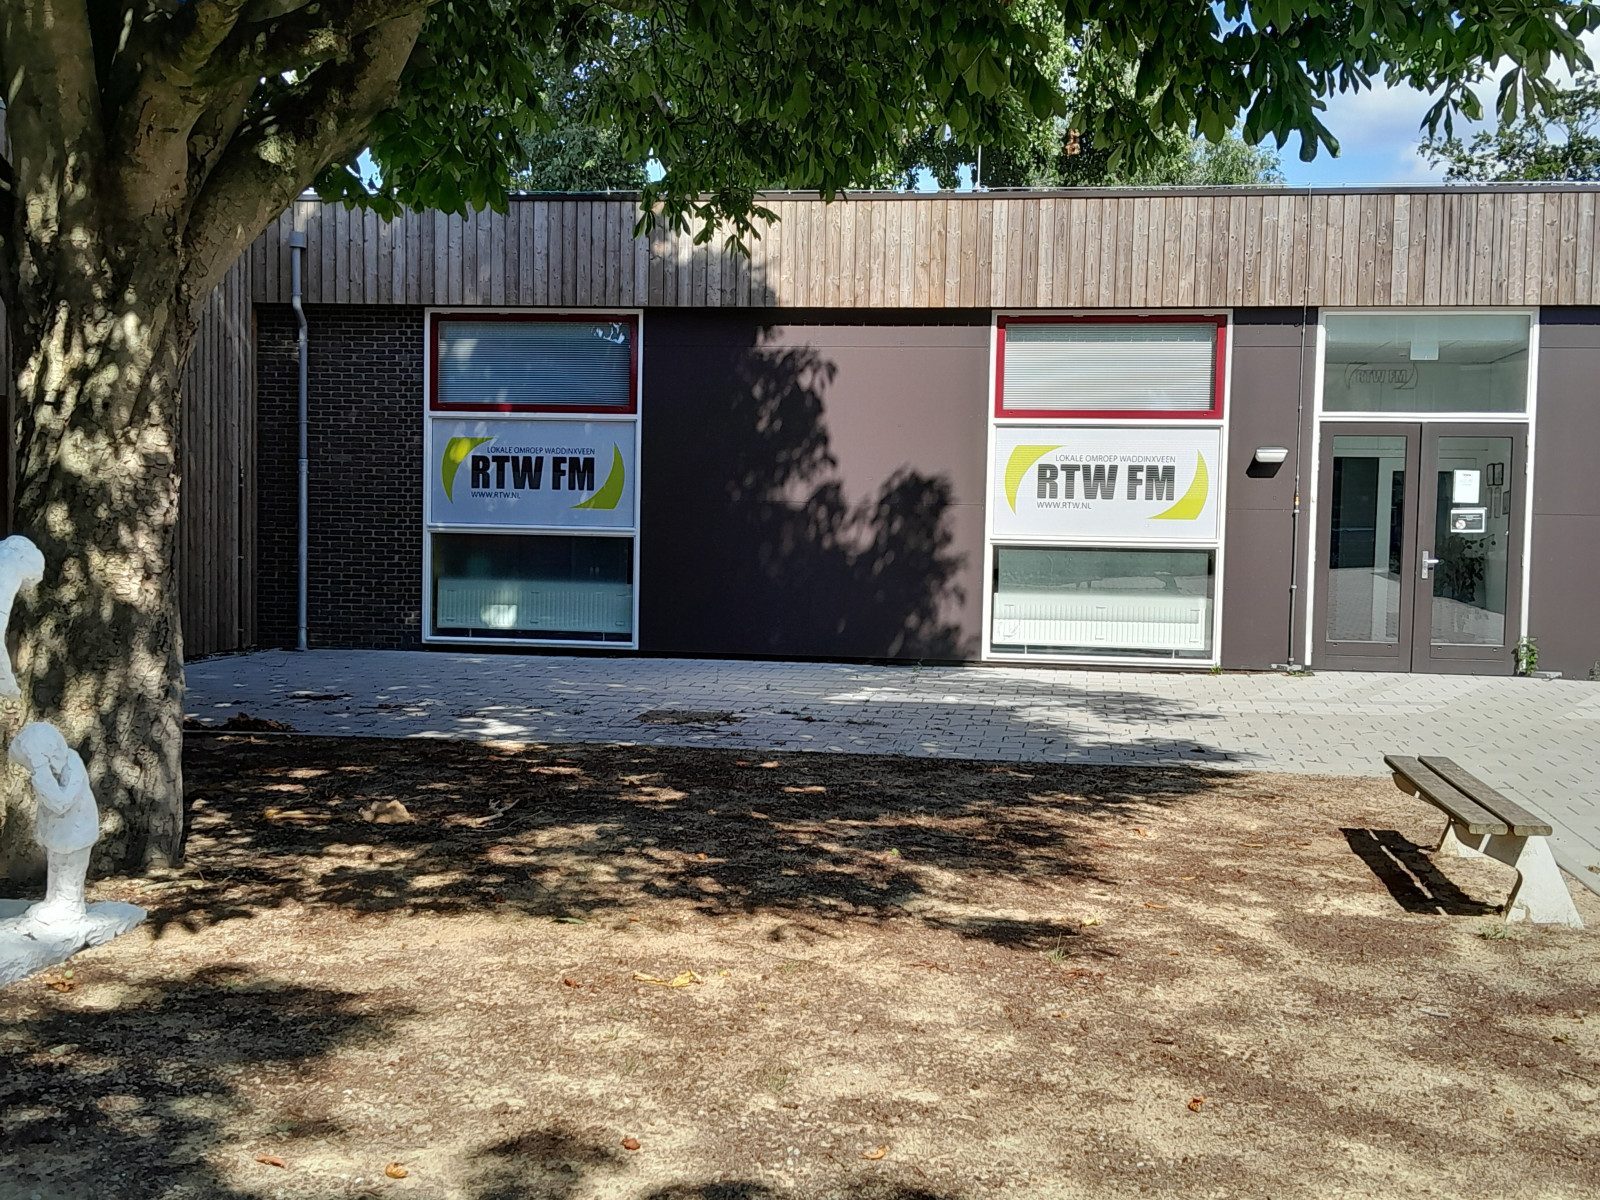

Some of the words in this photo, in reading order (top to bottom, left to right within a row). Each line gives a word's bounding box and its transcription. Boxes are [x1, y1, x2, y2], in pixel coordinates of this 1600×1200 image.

[1388, 369, 1408, 384] FM
[487, 446, 513, 454] LOKALE
[513, 446, 543, 454] OMROEP
[544, 447, 595, 456] WADDINXVEEN
[1055, 454, 1084, 462] LOKALE
[1085, 454, 1118, 463] OMROEP
[1119, 455, 1176, 463] WADDINXVEEN
[471, 455, 544, 490] RTW
[552, 456, 595, 491] FM
[1036, 463, 1119, 500] RTW
[1126, 464, 1176, 501] FM
[471, 491, 521, 499] WWW.RTW.NL
[1036, 501, 1092, 510] WWW.RTW.NL
